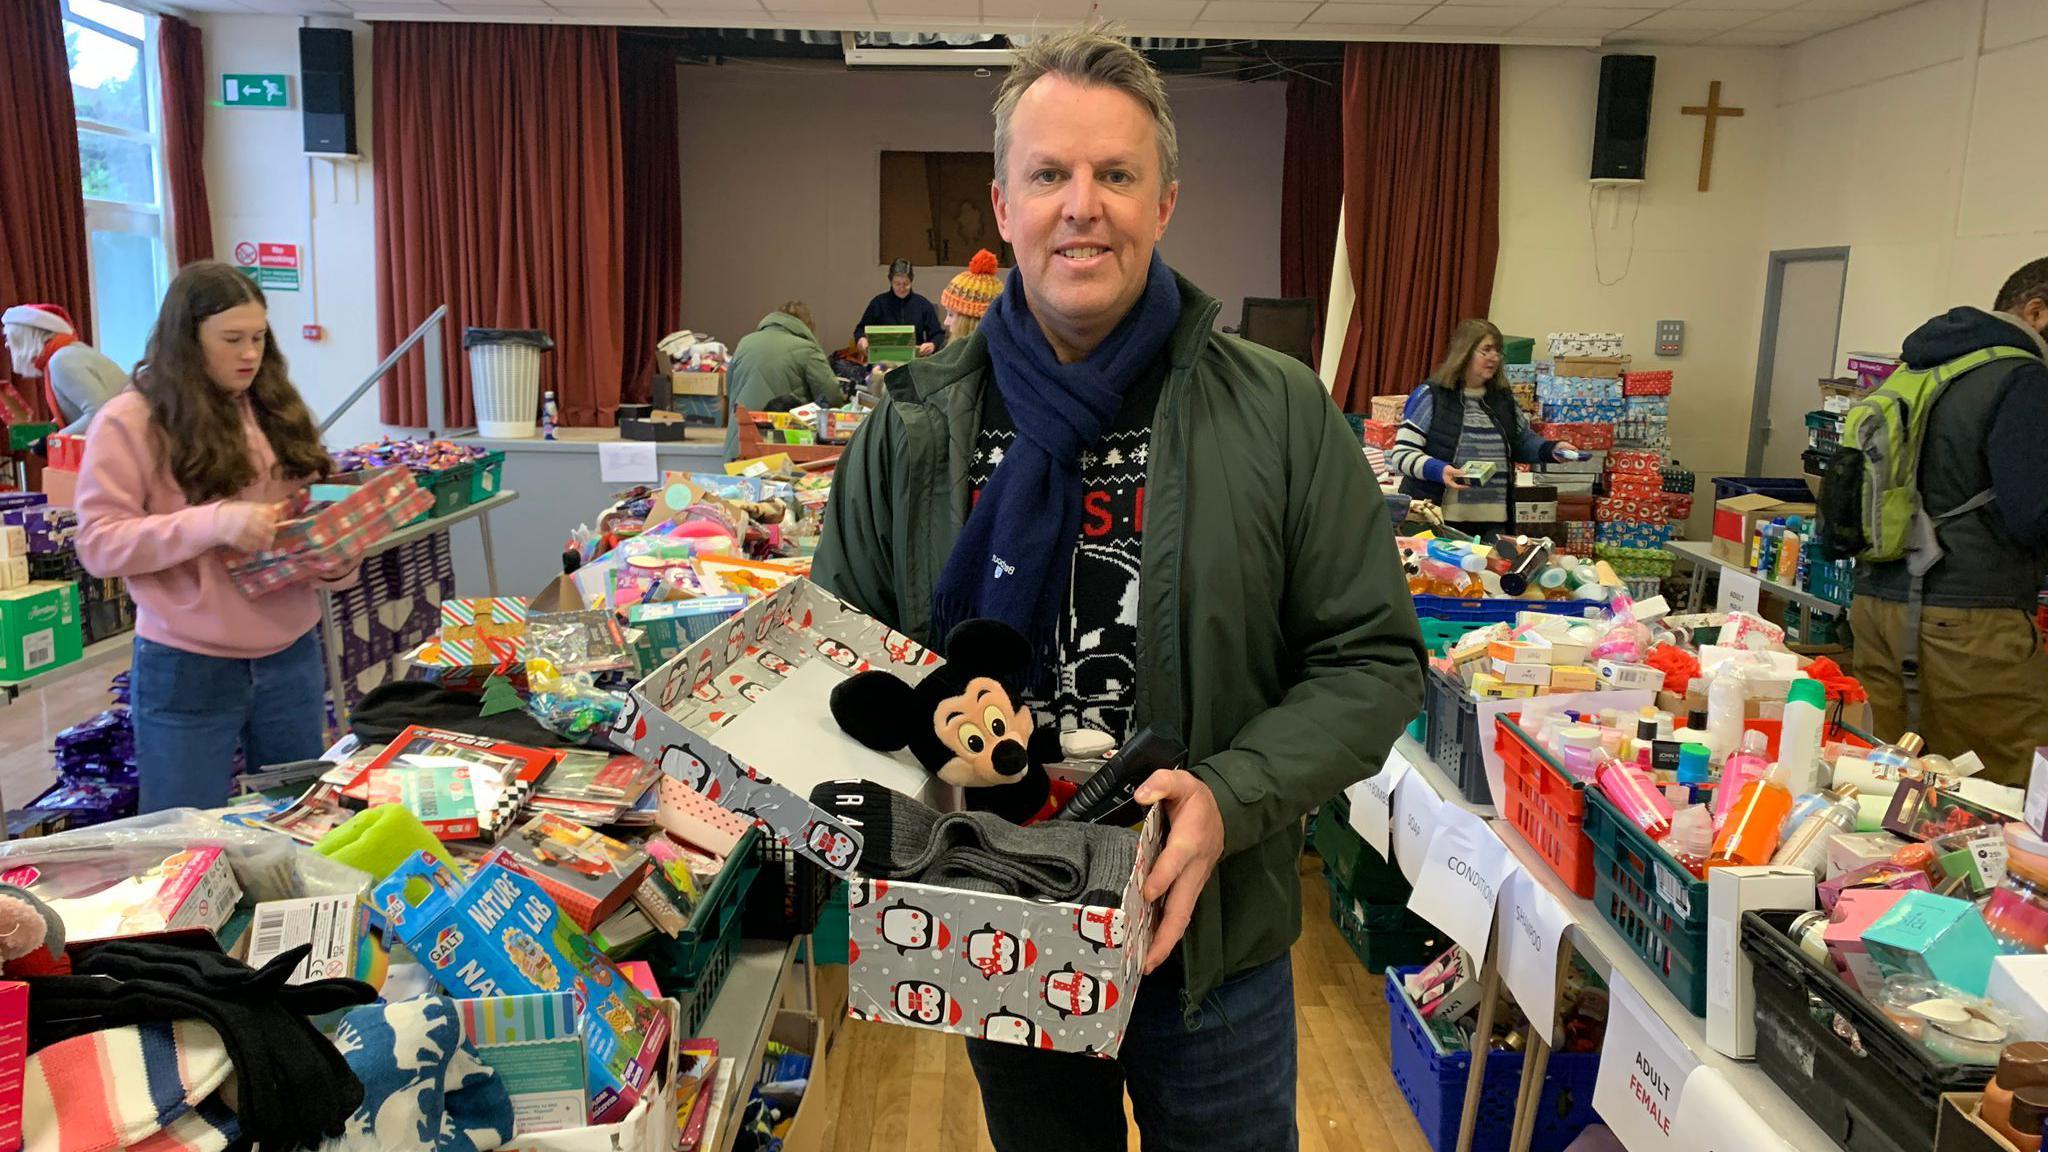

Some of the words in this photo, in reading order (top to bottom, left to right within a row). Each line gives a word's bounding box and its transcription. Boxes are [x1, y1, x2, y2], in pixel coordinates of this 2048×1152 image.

[468, 871, 522, 935] NATURE
[517, 895, 552, 935] LAB
[430, 933, 463, 963] GALT
[1635, 1050, 1671, 1102] ADULT
[1629, 1073, 1671, 1137] FEMALE
